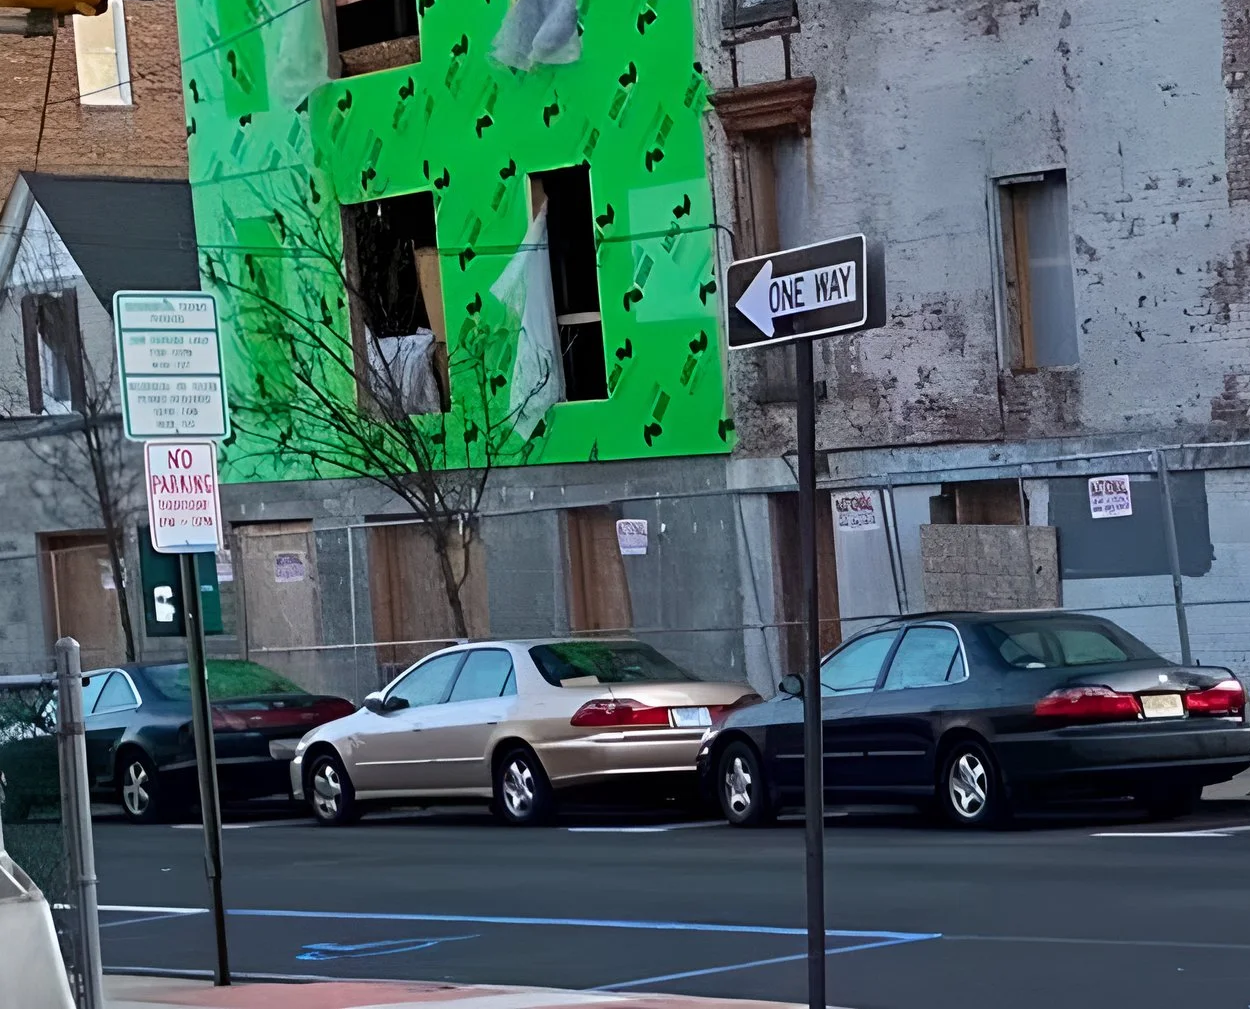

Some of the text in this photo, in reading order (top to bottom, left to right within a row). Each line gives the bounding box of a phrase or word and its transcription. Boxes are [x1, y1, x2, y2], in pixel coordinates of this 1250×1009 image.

[769, 265, 851, 313] ONE WAY
[168, 448, 193, 469] NO
